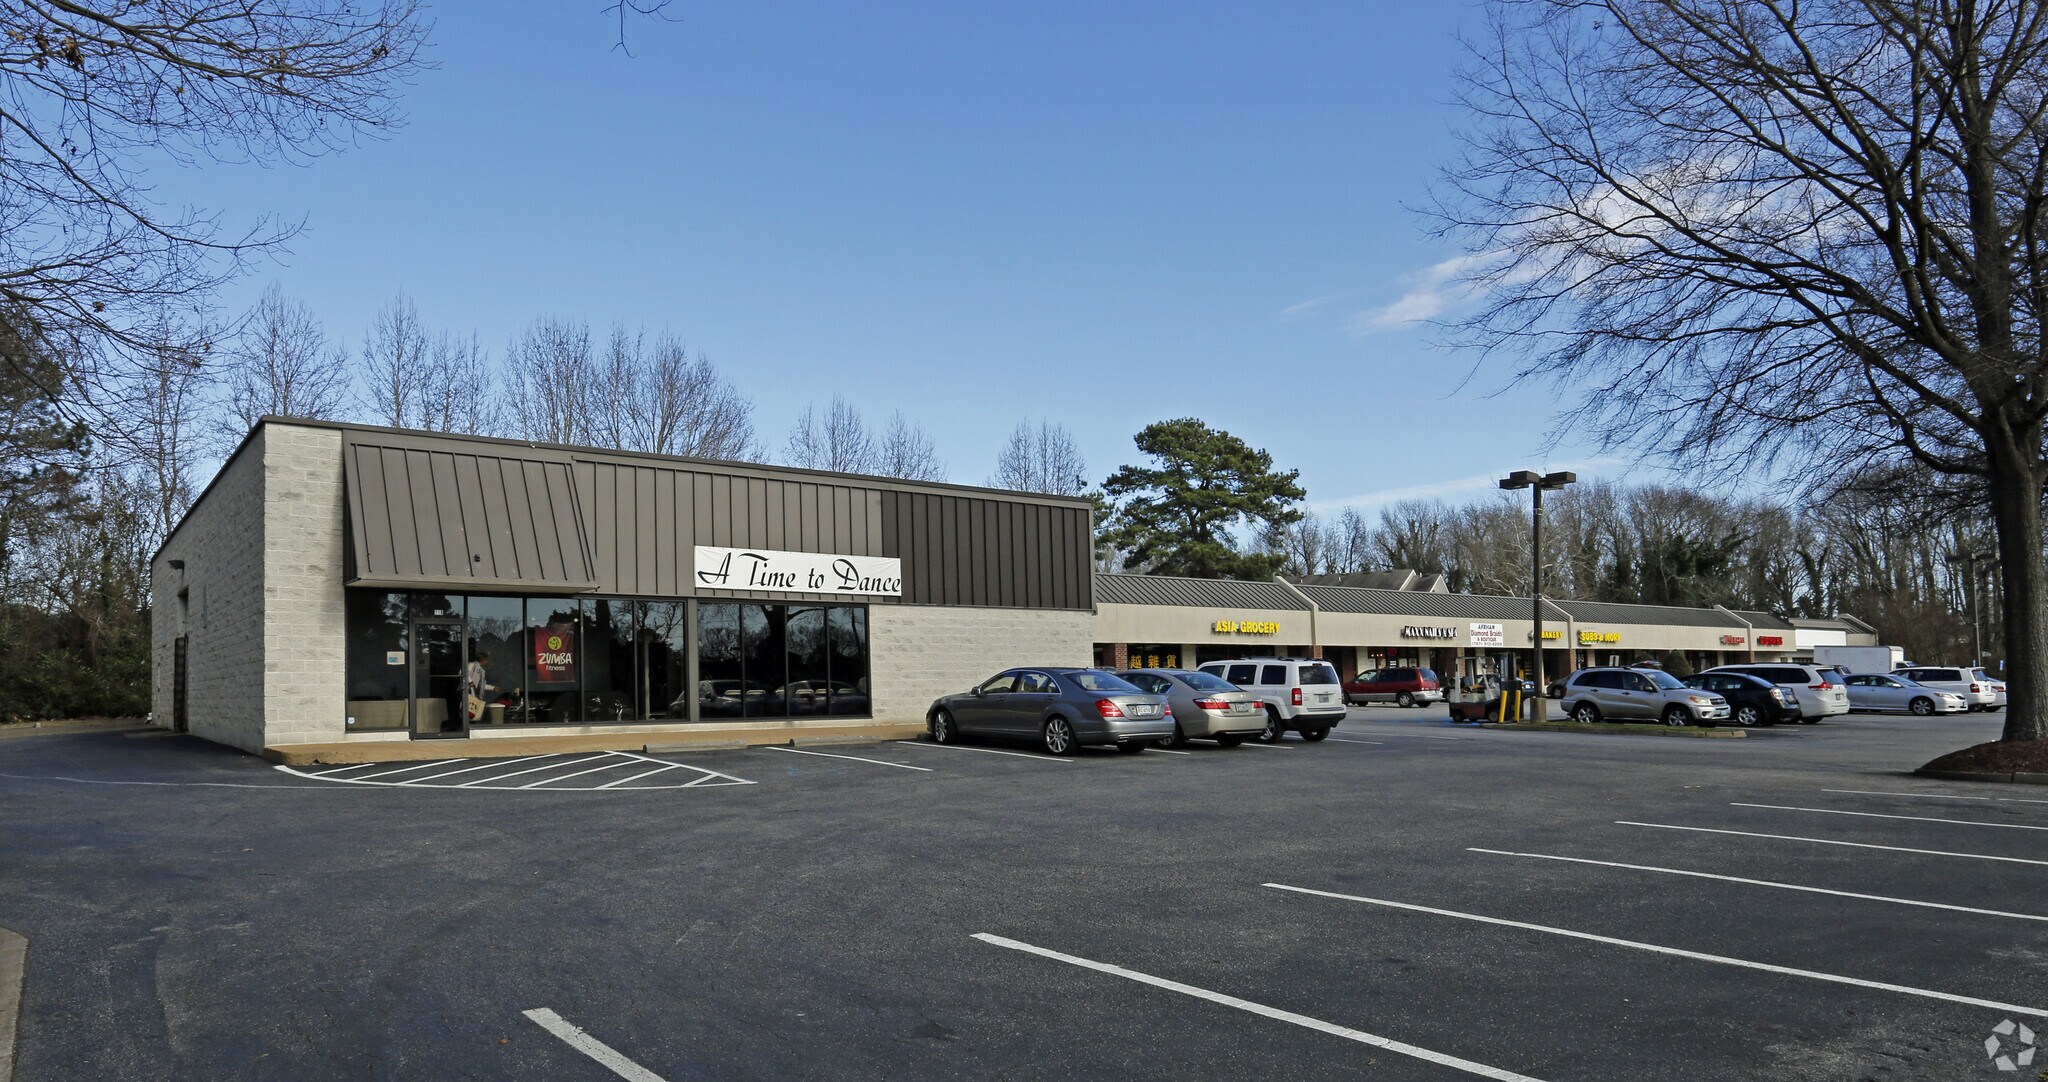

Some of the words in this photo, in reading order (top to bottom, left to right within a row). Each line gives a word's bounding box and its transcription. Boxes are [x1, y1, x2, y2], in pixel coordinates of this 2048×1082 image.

[697, 552, 732, 584] A
[737, 553, 795, 587] Time
[808, 568, 825, 589] to
[832, 558, 901, 592] Dance
[1216, 620, 1237, 632] ASIA
[1240, 621, 1280, 633] GROCERY
[1541, 631, 1562, 639] BAKERY
[1581, 631, 1598, 641] SUBS
[537, 652, 573, 665] ZUMBA
